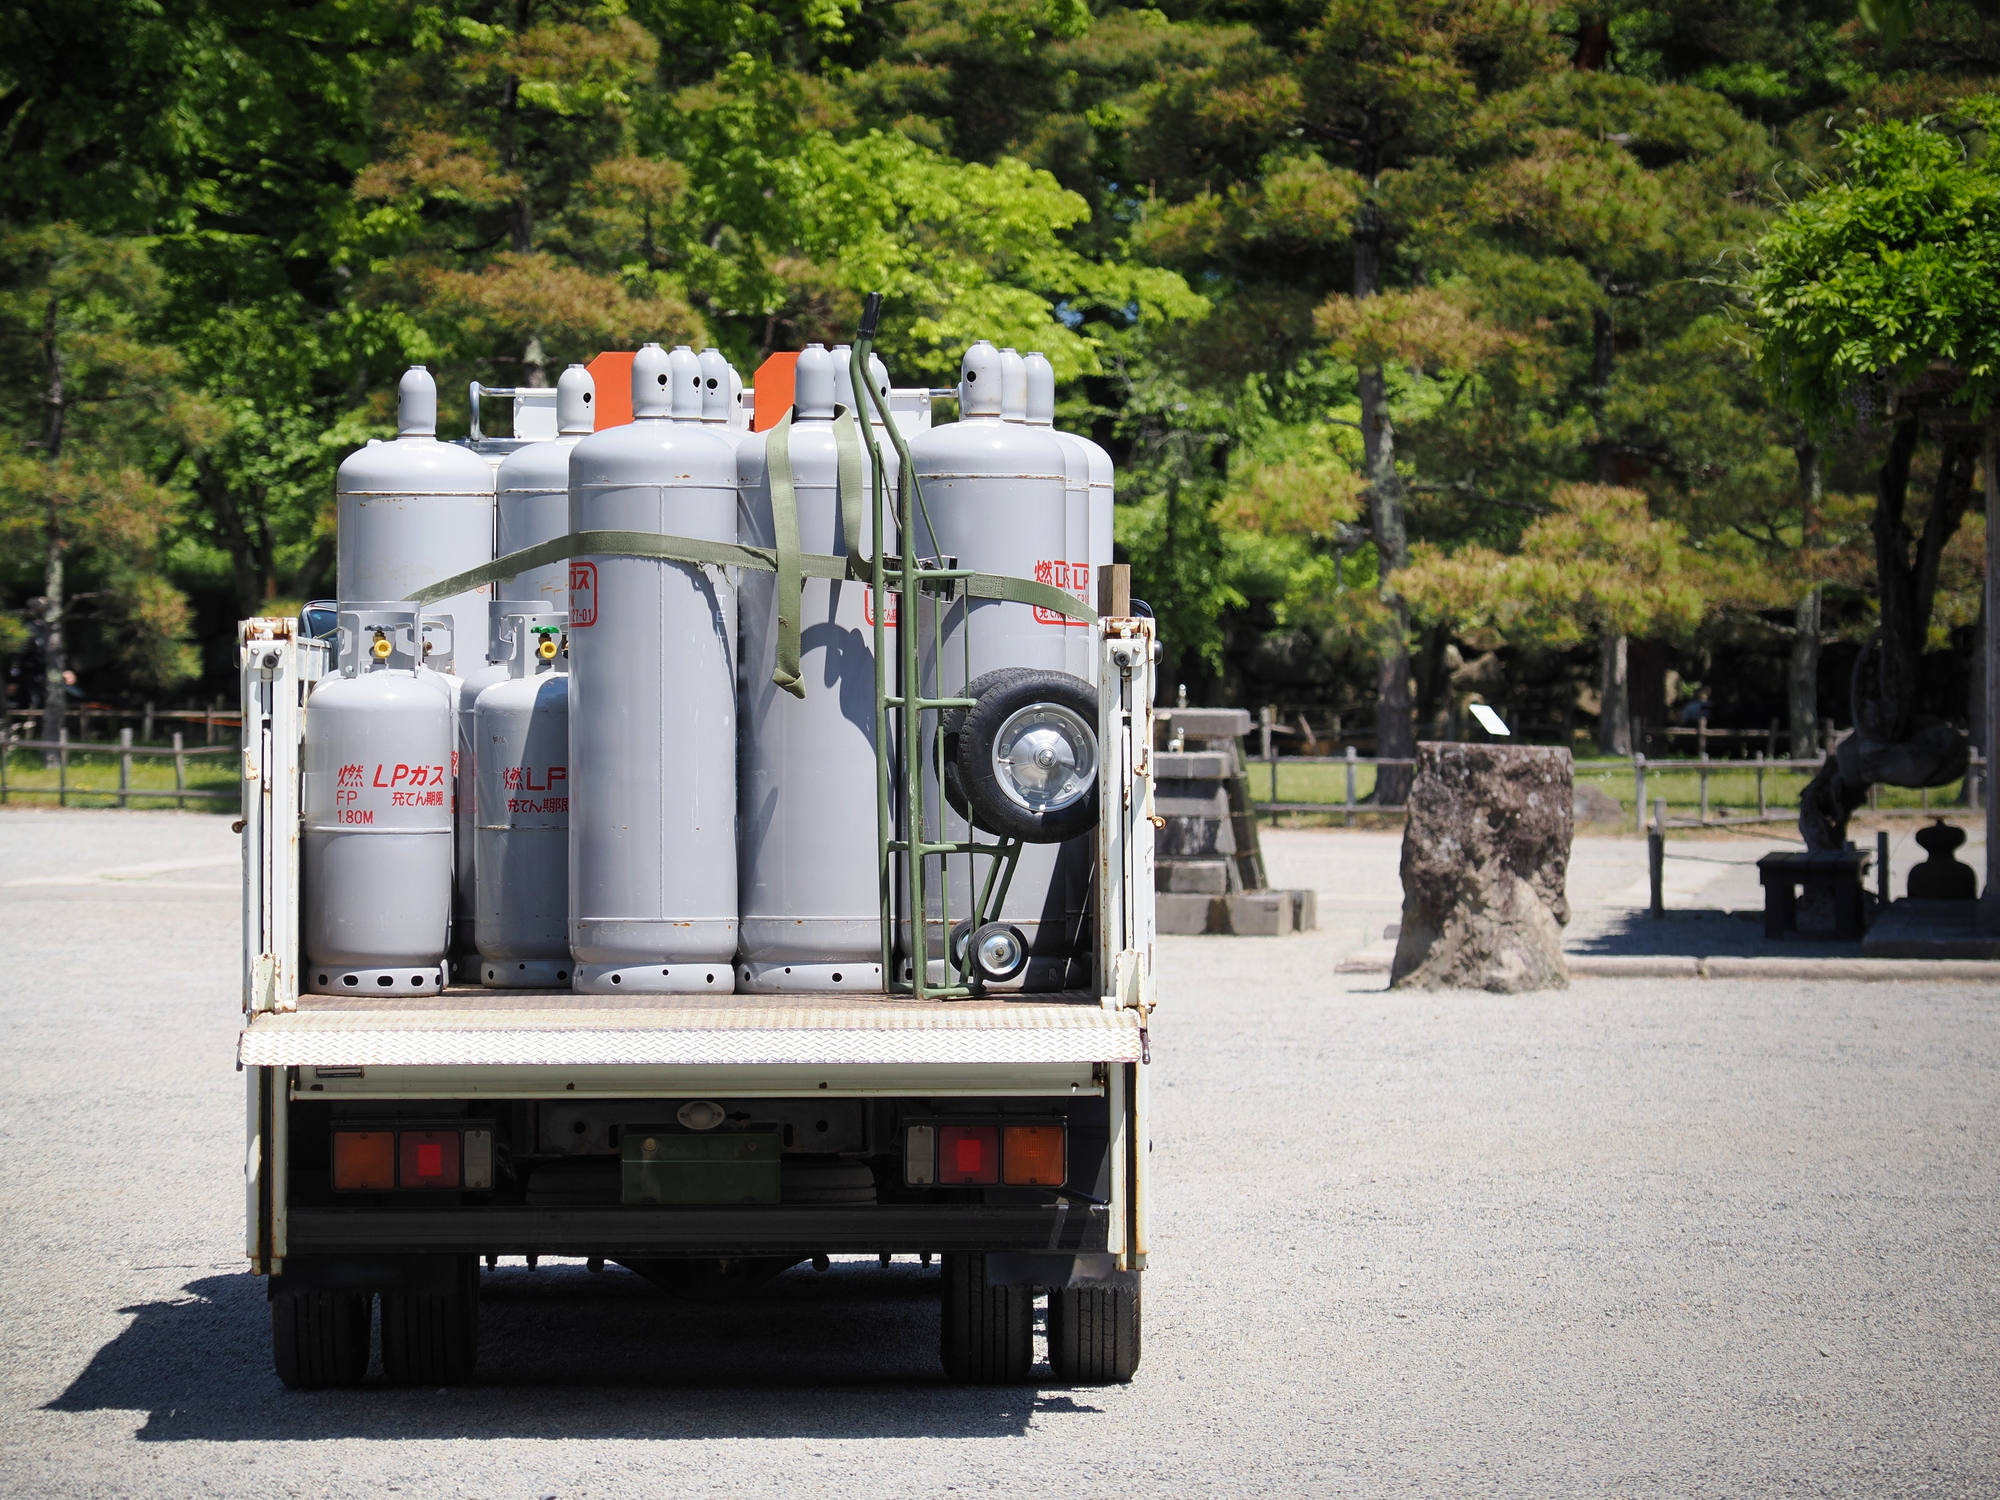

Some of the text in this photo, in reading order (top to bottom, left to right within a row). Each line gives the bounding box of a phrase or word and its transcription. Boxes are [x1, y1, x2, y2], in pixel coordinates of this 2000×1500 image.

[337, 763, 364, 787] 燃
[373, 764, 444, 787] LPガス
[503, 767, 567, 791] 燃 LP
[336, 790, 358, 806] FP
[391, 791, 444, 806] 充てん期限
[508, 798, 569, 813] 充てん期限
[337, 810, 373, 824] 1.80M
